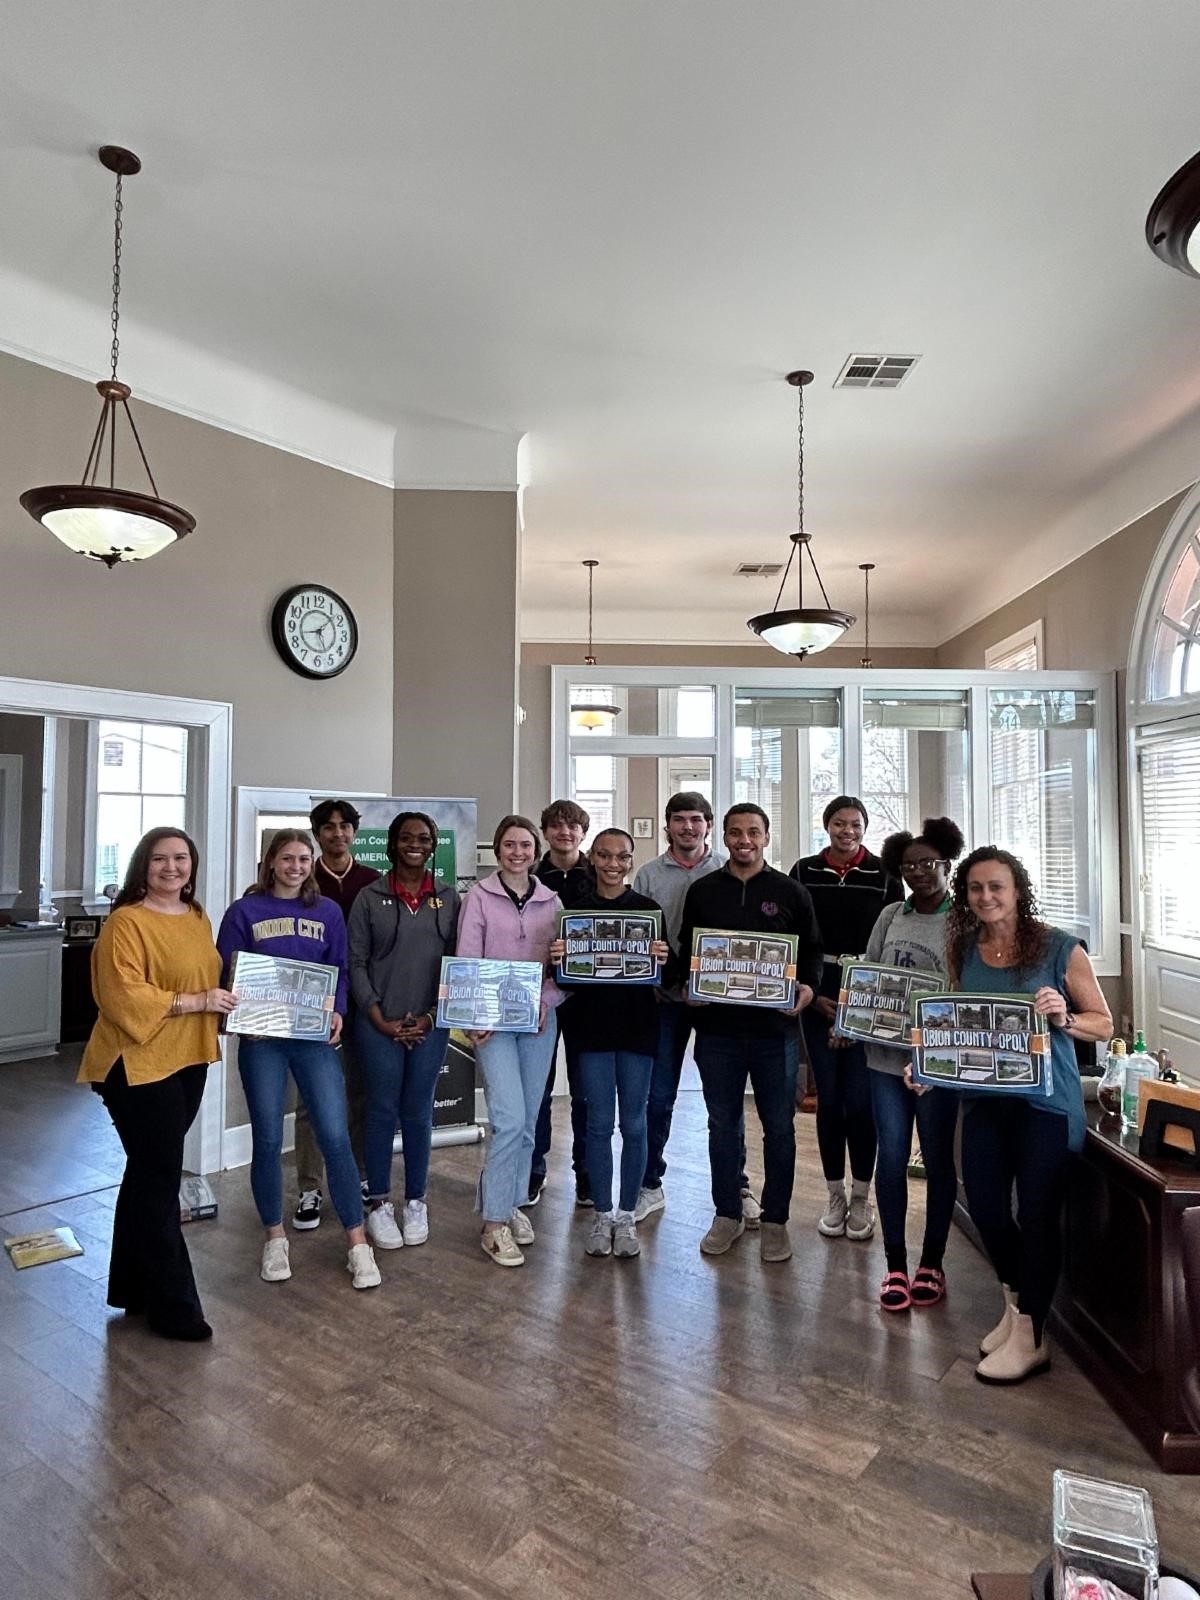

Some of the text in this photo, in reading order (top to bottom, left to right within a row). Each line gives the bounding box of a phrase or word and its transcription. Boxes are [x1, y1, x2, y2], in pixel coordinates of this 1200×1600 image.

[301, 596, 310, 609] 11
[314, 595, 325, 609] 12
[291, 605, 302, 619] 10
[329, 603, 333, 615] 1
[288, 620, 296, 633] 9
[337, 615, 344, 627] 2
[291, 635, 299, 648] 8
[340, 630, 348, 643] 3
[301, 649, 308, 661] 7
[336, 645, 343, 657] 4
[314, 655, 321, 667] 6
[327, 654, 334, 666] 5
[369, 836, 387, 845] Cou
[355, 853, 388, 862] AMERI
[566, 939, 651, 955] OBION COUNTY OPOLY
[700, 957, 785, 978] OBION COUNTY OPOLY
[242, 985, 325, 1008] OBION COUNTY OPOLY
[448, 985, 471, 999] OBION
[848, 990, 906, 1012] OBION COUNTY
[922, 1028, 1030, 1053] OBION COUNTY OPOLY
